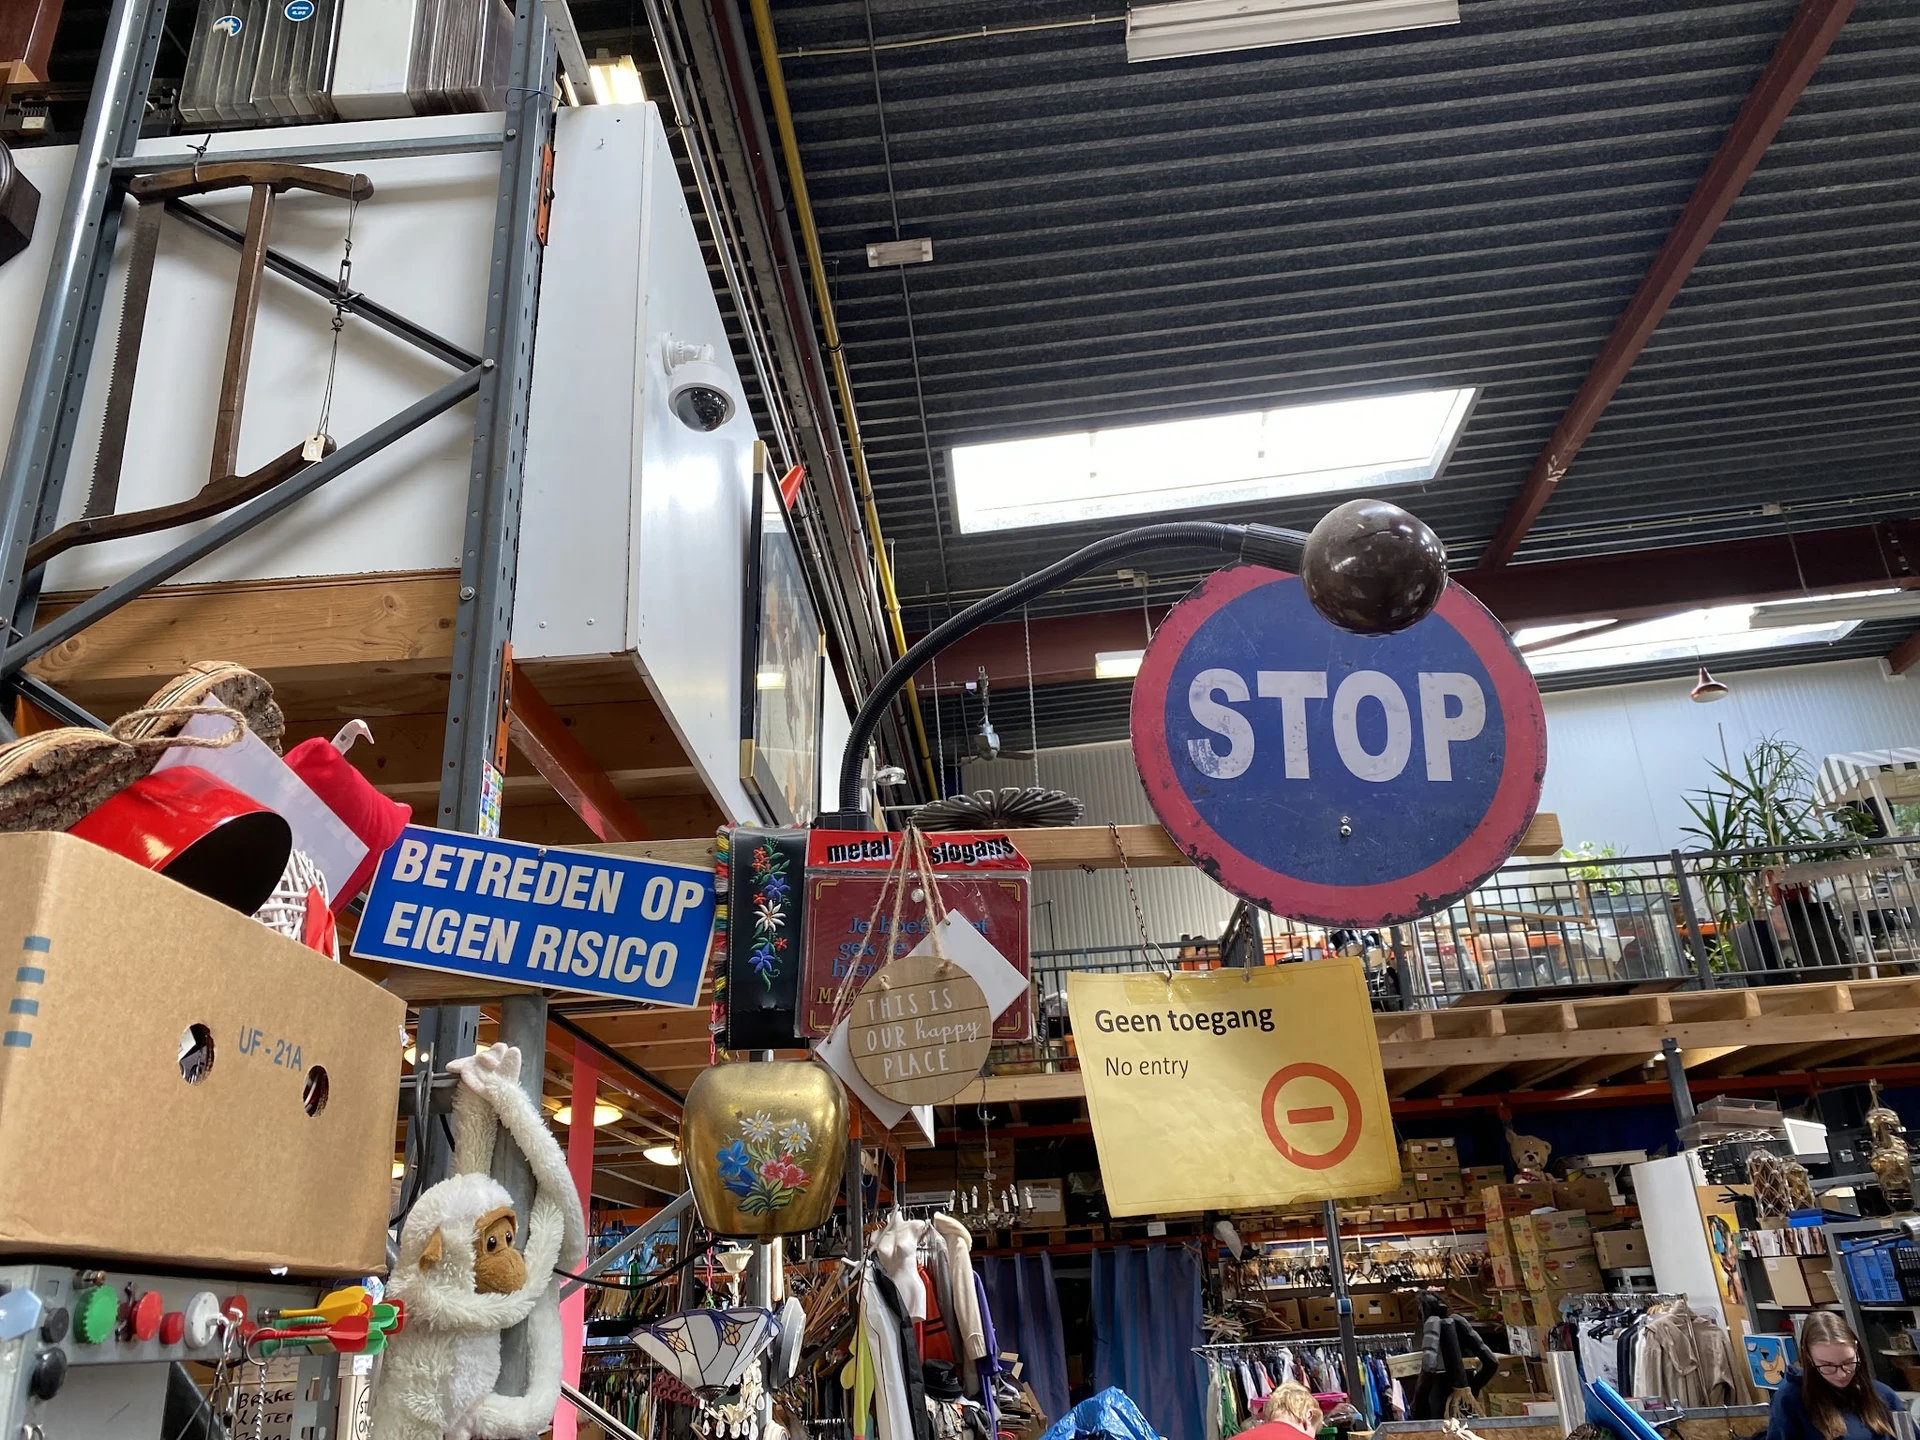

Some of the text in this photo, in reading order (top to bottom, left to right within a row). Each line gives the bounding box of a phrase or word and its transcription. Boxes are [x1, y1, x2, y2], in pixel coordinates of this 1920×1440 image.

[1187, 668, 1487, 783] STOP
[827, 836, 1017, 865] metal slogans
[391, 838, 705, 924] BETREDEN OP
[383, 901, 679, 988] EIGEN RISICO
[867, 987, 953, 1021] THIS IS
[867, 1018, 982, 1052] OUR happy
[1095, 1007, 1276, 1036] Geen toegang
[884, 1048, 950, 1080] PLACE
[1105, 1056, 1189, 1079] No entry
